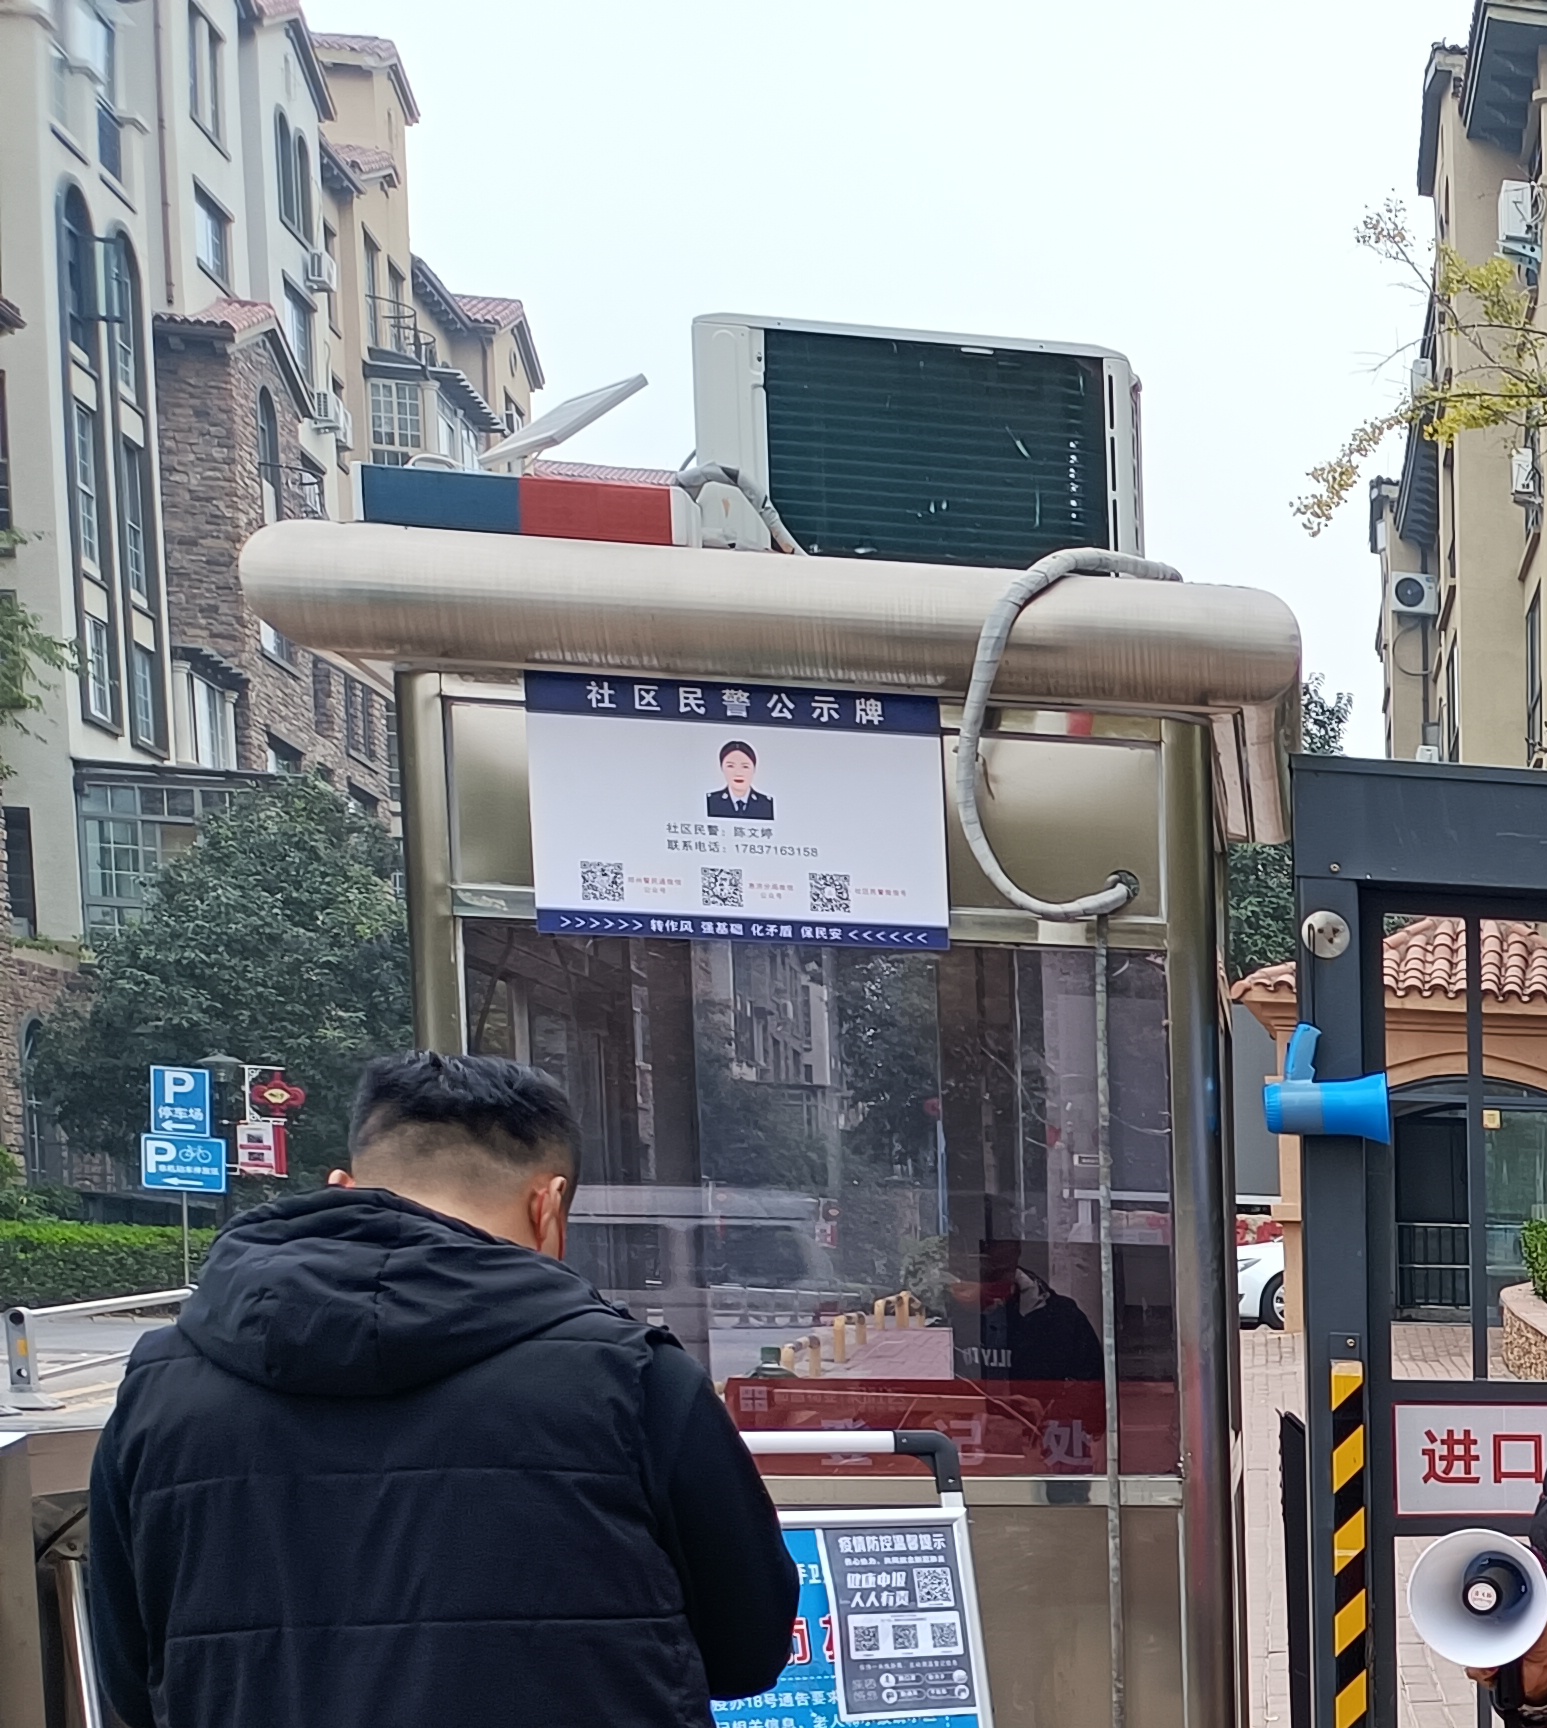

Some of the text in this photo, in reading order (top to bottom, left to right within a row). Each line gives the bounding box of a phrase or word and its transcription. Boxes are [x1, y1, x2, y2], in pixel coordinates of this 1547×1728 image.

[586, 681, 885, 726] 社区民警公示牌
[650, 918, 694, 933] 转作风
[751, 923, 793, 938] 化矛盾
[800, 925, 842, 940] 保民安
[164, 1070, 195, 1104] P
[158, 1105, 204, 1121] 停车场
[146, 1140, 177, 1174] P
[1421, 1428, 1543, 1485] 进口
